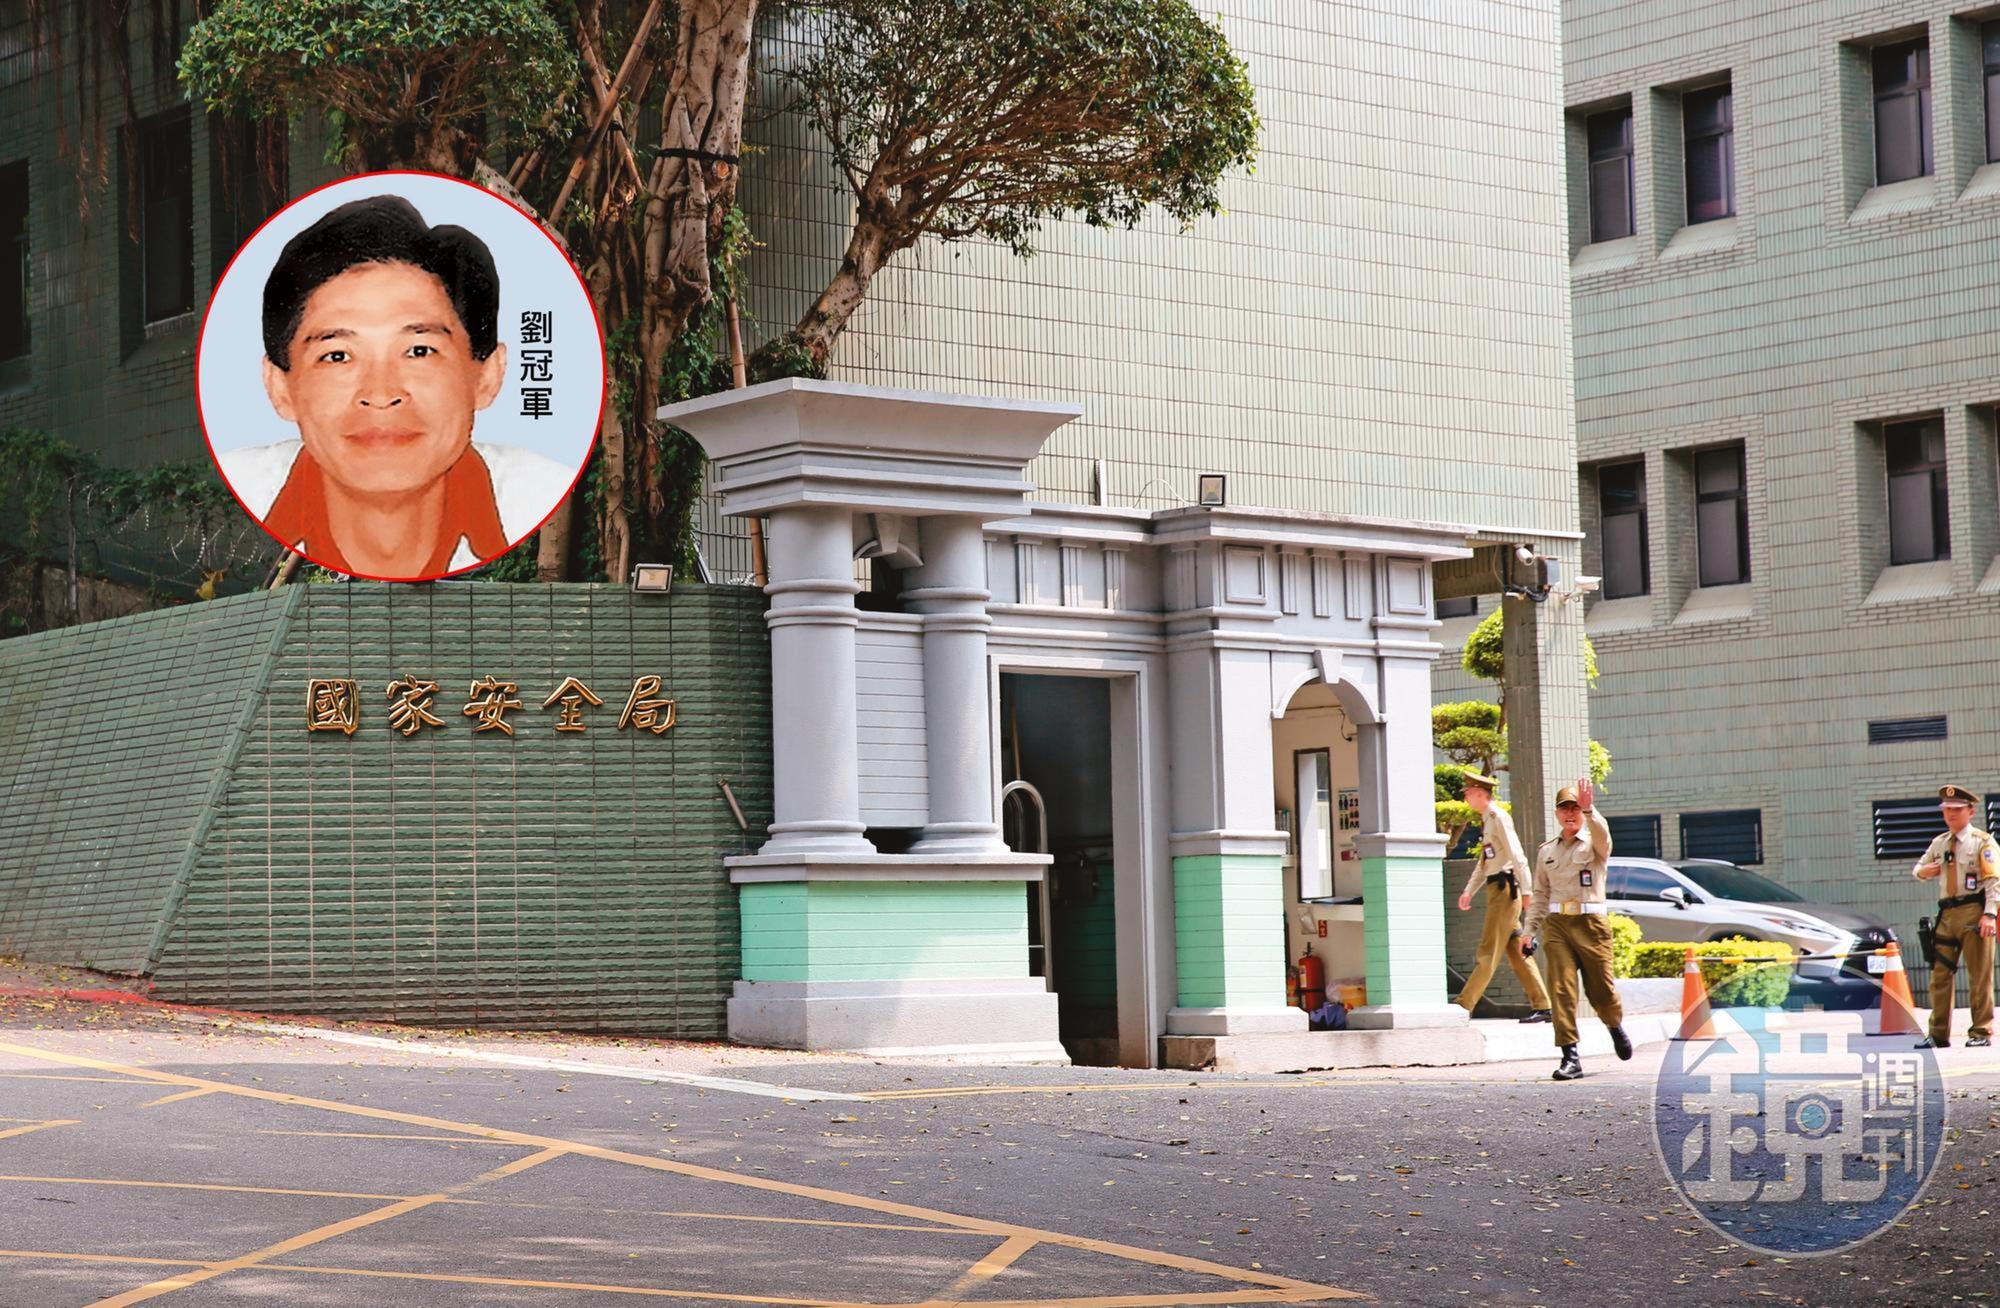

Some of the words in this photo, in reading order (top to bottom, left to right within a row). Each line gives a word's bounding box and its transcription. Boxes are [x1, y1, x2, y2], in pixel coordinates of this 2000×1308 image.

[306, 673, 677, 736] 國家安全局
